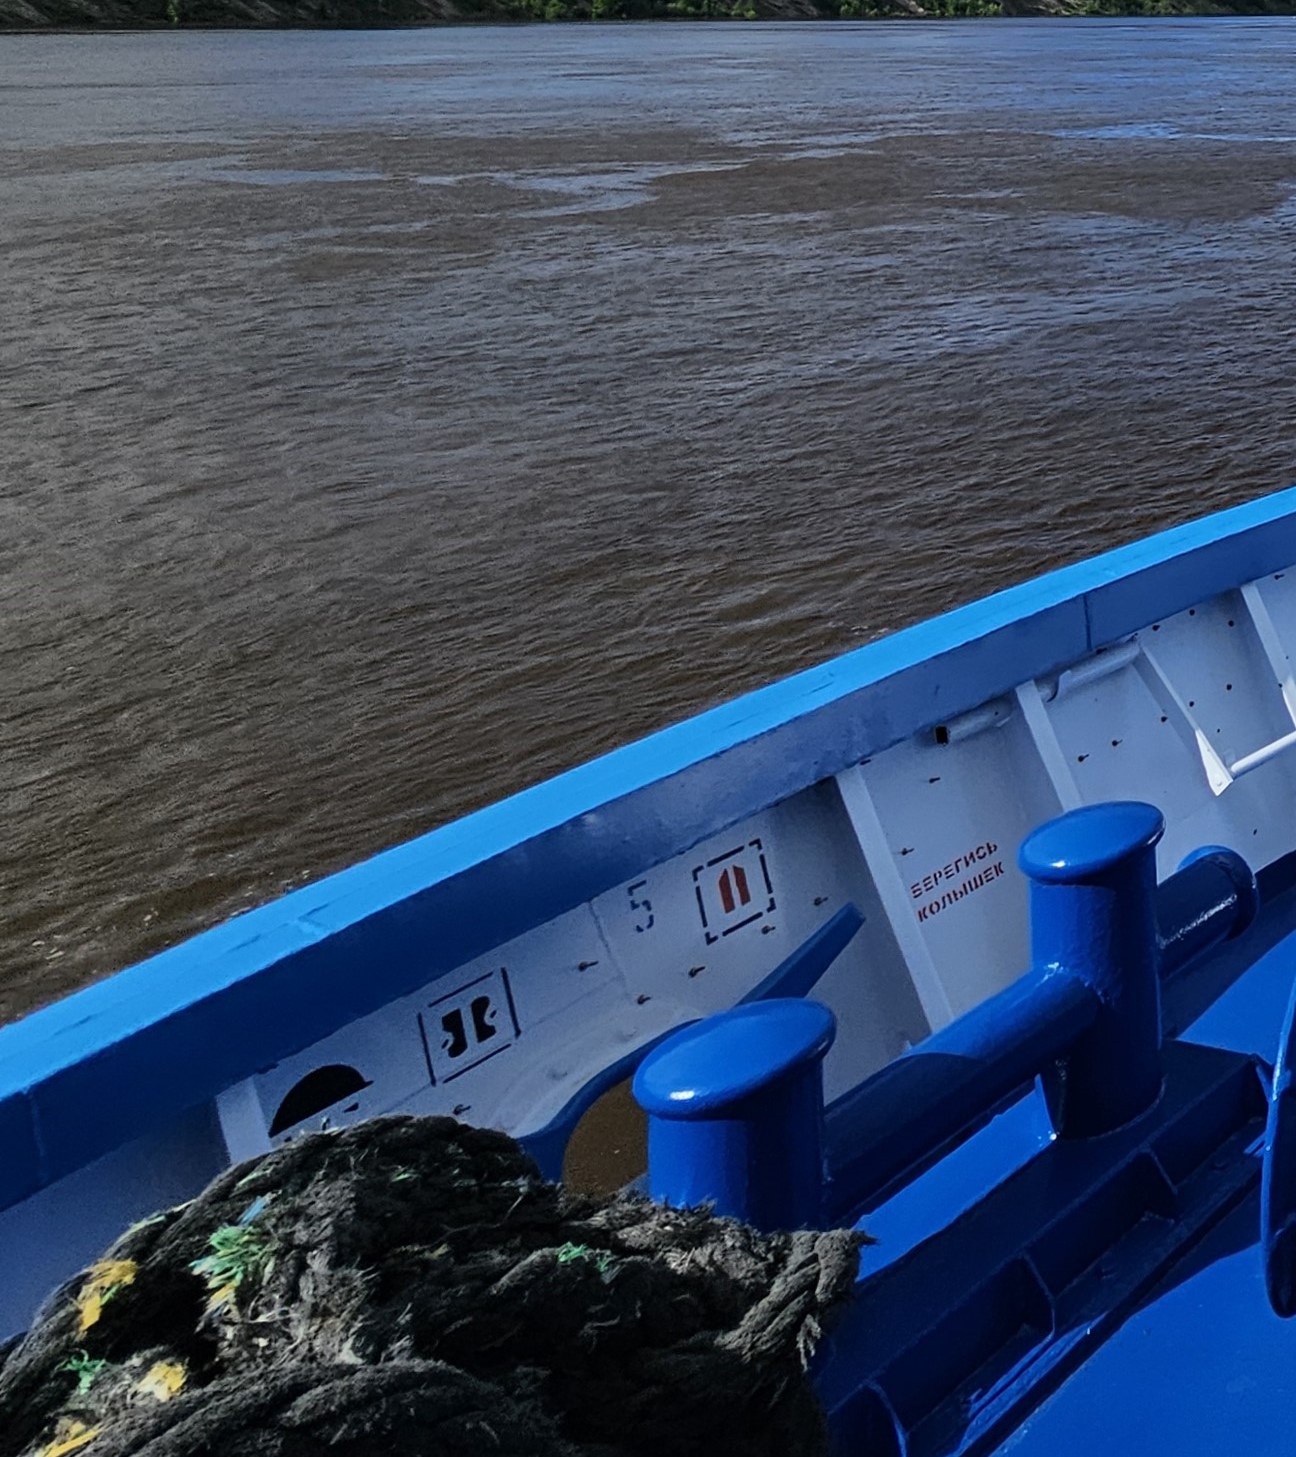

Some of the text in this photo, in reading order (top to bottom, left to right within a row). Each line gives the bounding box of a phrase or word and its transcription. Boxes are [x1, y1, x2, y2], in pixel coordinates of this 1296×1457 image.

[911, 842, 998, 899] БЕРЕГИСЬ
[918, 861, 1004, 922] КОЛЫШЕК
[627, 880, 654, 933] 5
